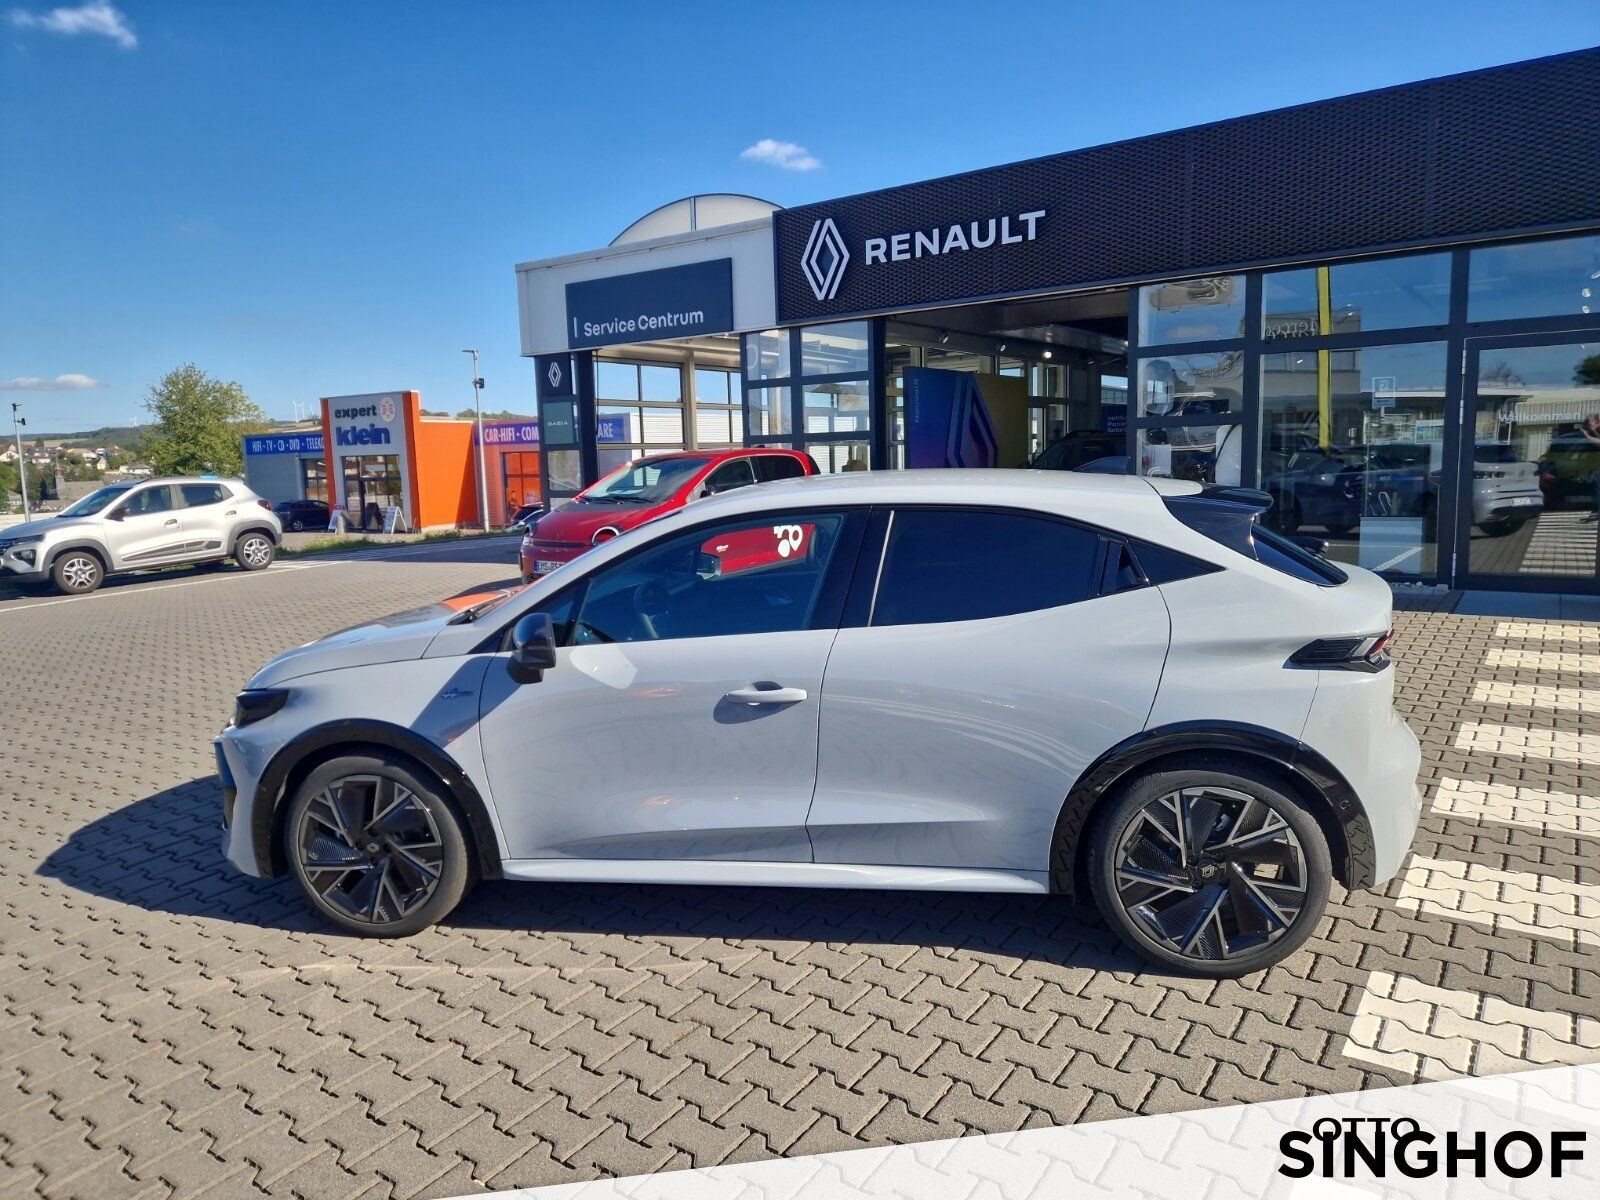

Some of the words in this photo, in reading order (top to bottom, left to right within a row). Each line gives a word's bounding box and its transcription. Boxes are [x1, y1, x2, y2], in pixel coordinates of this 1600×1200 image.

[865, 210, 1046, 266] RENAULT
[335, 405, 377, 419] expert
[336, 423, 391, 446] klein
[484, 427, 516, 443] CAR-HIFI
[266, 440, 273, 451] TV
[277, 440, 285, 452] CD
[289, 439, 300, 451] DVD
